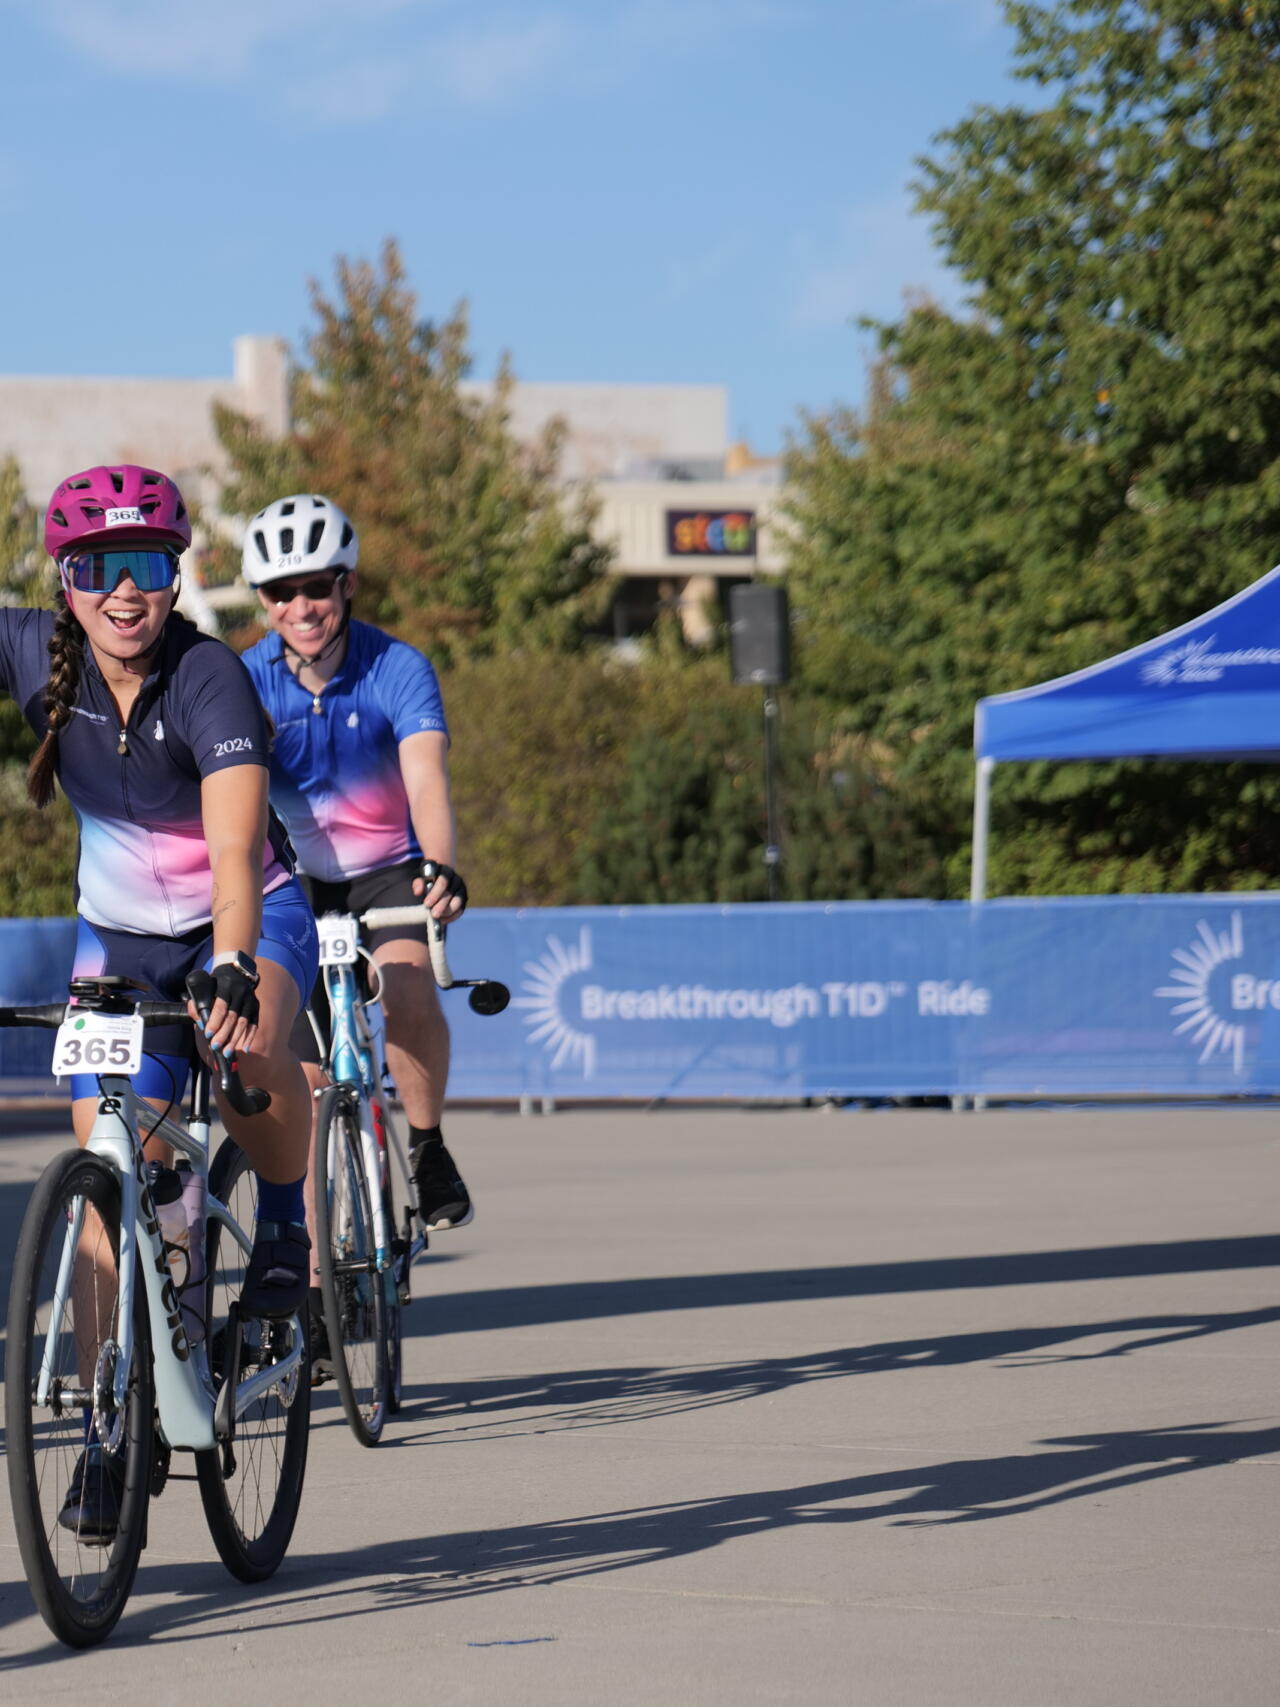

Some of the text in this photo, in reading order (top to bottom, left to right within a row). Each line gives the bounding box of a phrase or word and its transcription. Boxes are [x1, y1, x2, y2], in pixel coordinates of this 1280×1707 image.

[108, 510, 141, 523] 365
[278, 555, 302, 568] 219
[214, 737, 252, 757] 2024
[581, 983, 819, 1028] Breakthrough
[919, 979, 991, 1016] Ride
[62, 1038, 131, 1066] 365
